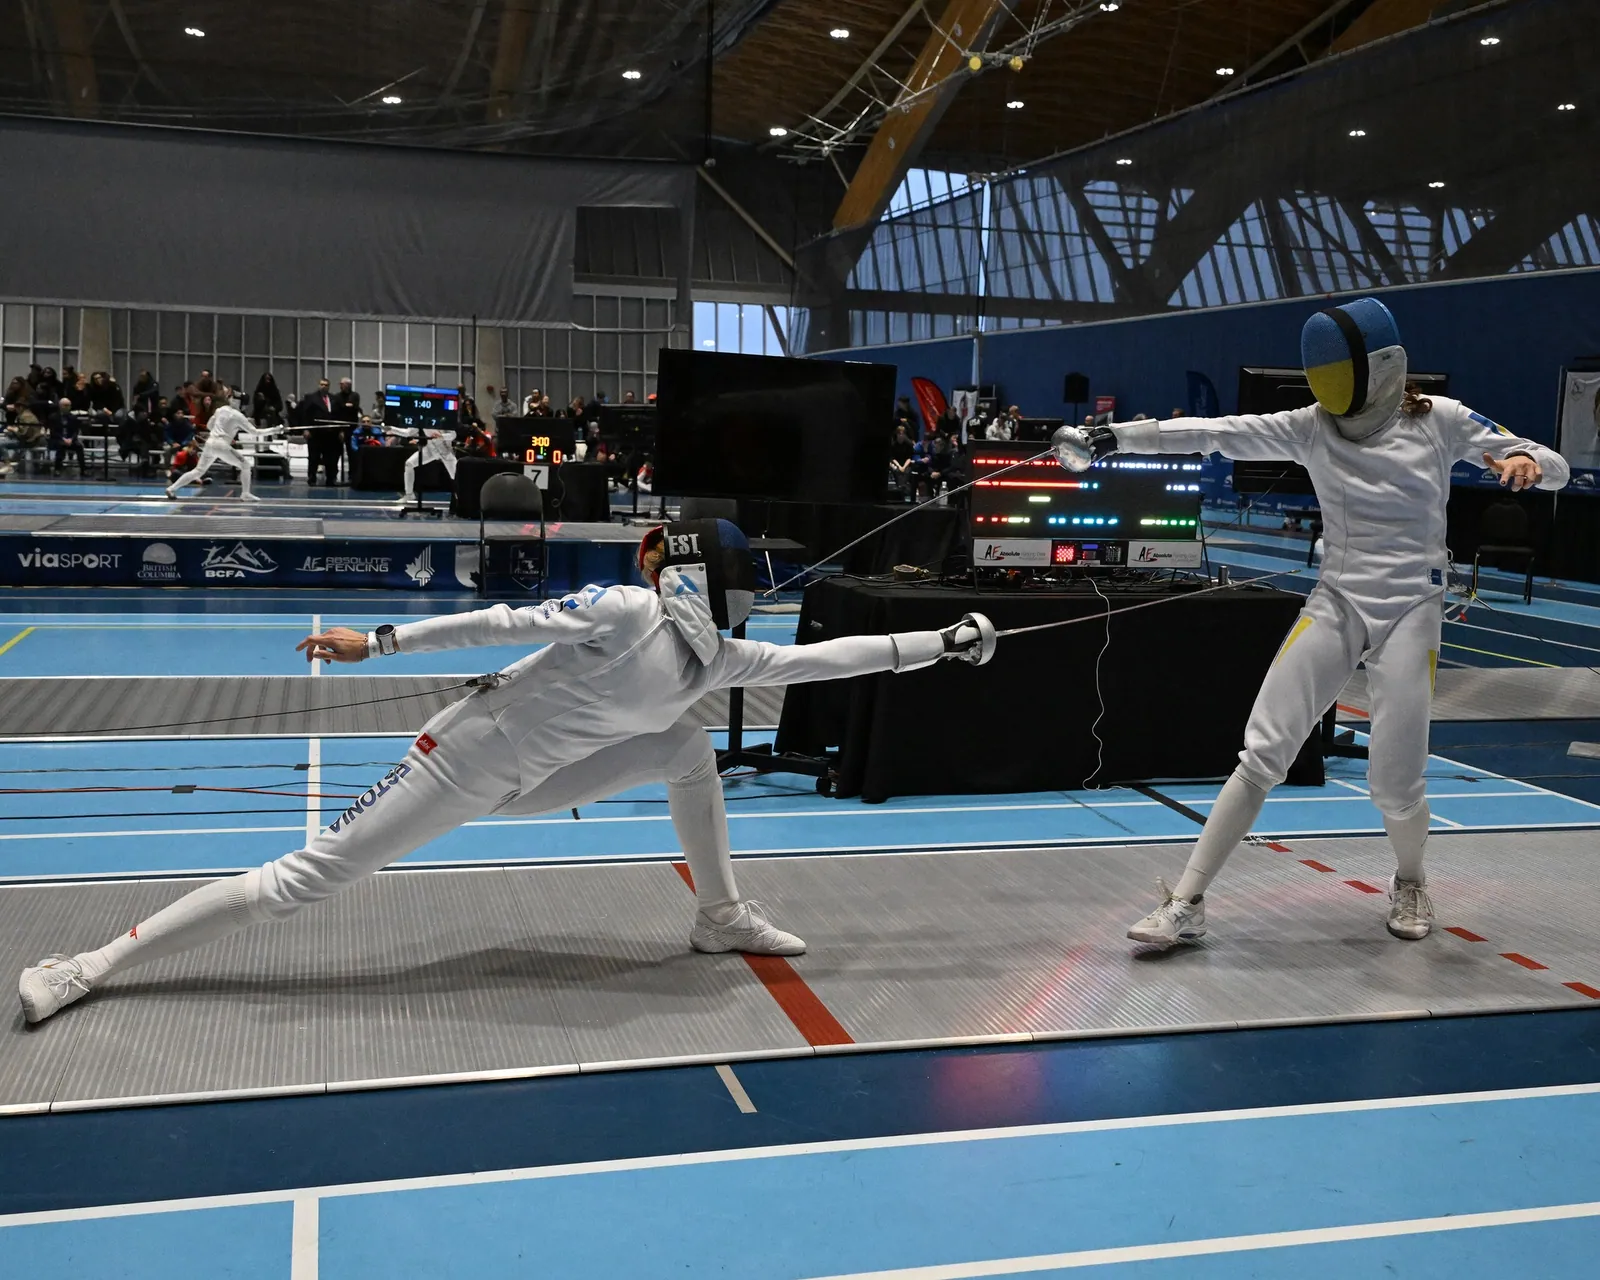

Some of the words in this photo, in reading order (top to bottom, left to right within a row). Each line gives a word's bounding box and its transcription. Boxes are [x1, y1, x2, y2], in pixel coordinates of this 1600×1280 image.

[413, 400, 432, 409] 1:40
[404, 417, 413, 425] 12
[531, 436, 550, 447] 3:00
[526, 449, 535, 463] 0
[552, 450, 562, 464] 0
[531, 469, 542, 484] 7
[668, 533, 699, 556] EST
[325, 556, 390, 564] ABSOLUTE
[142, 564, 177, 572] BRITISH
[325, 564, 389, 572] FENCING
[137, 571, 182, 579] COLUMBIA
[205, 570, 246, 578] BCFA
[329, 763, 412, 834] ESTONIA
